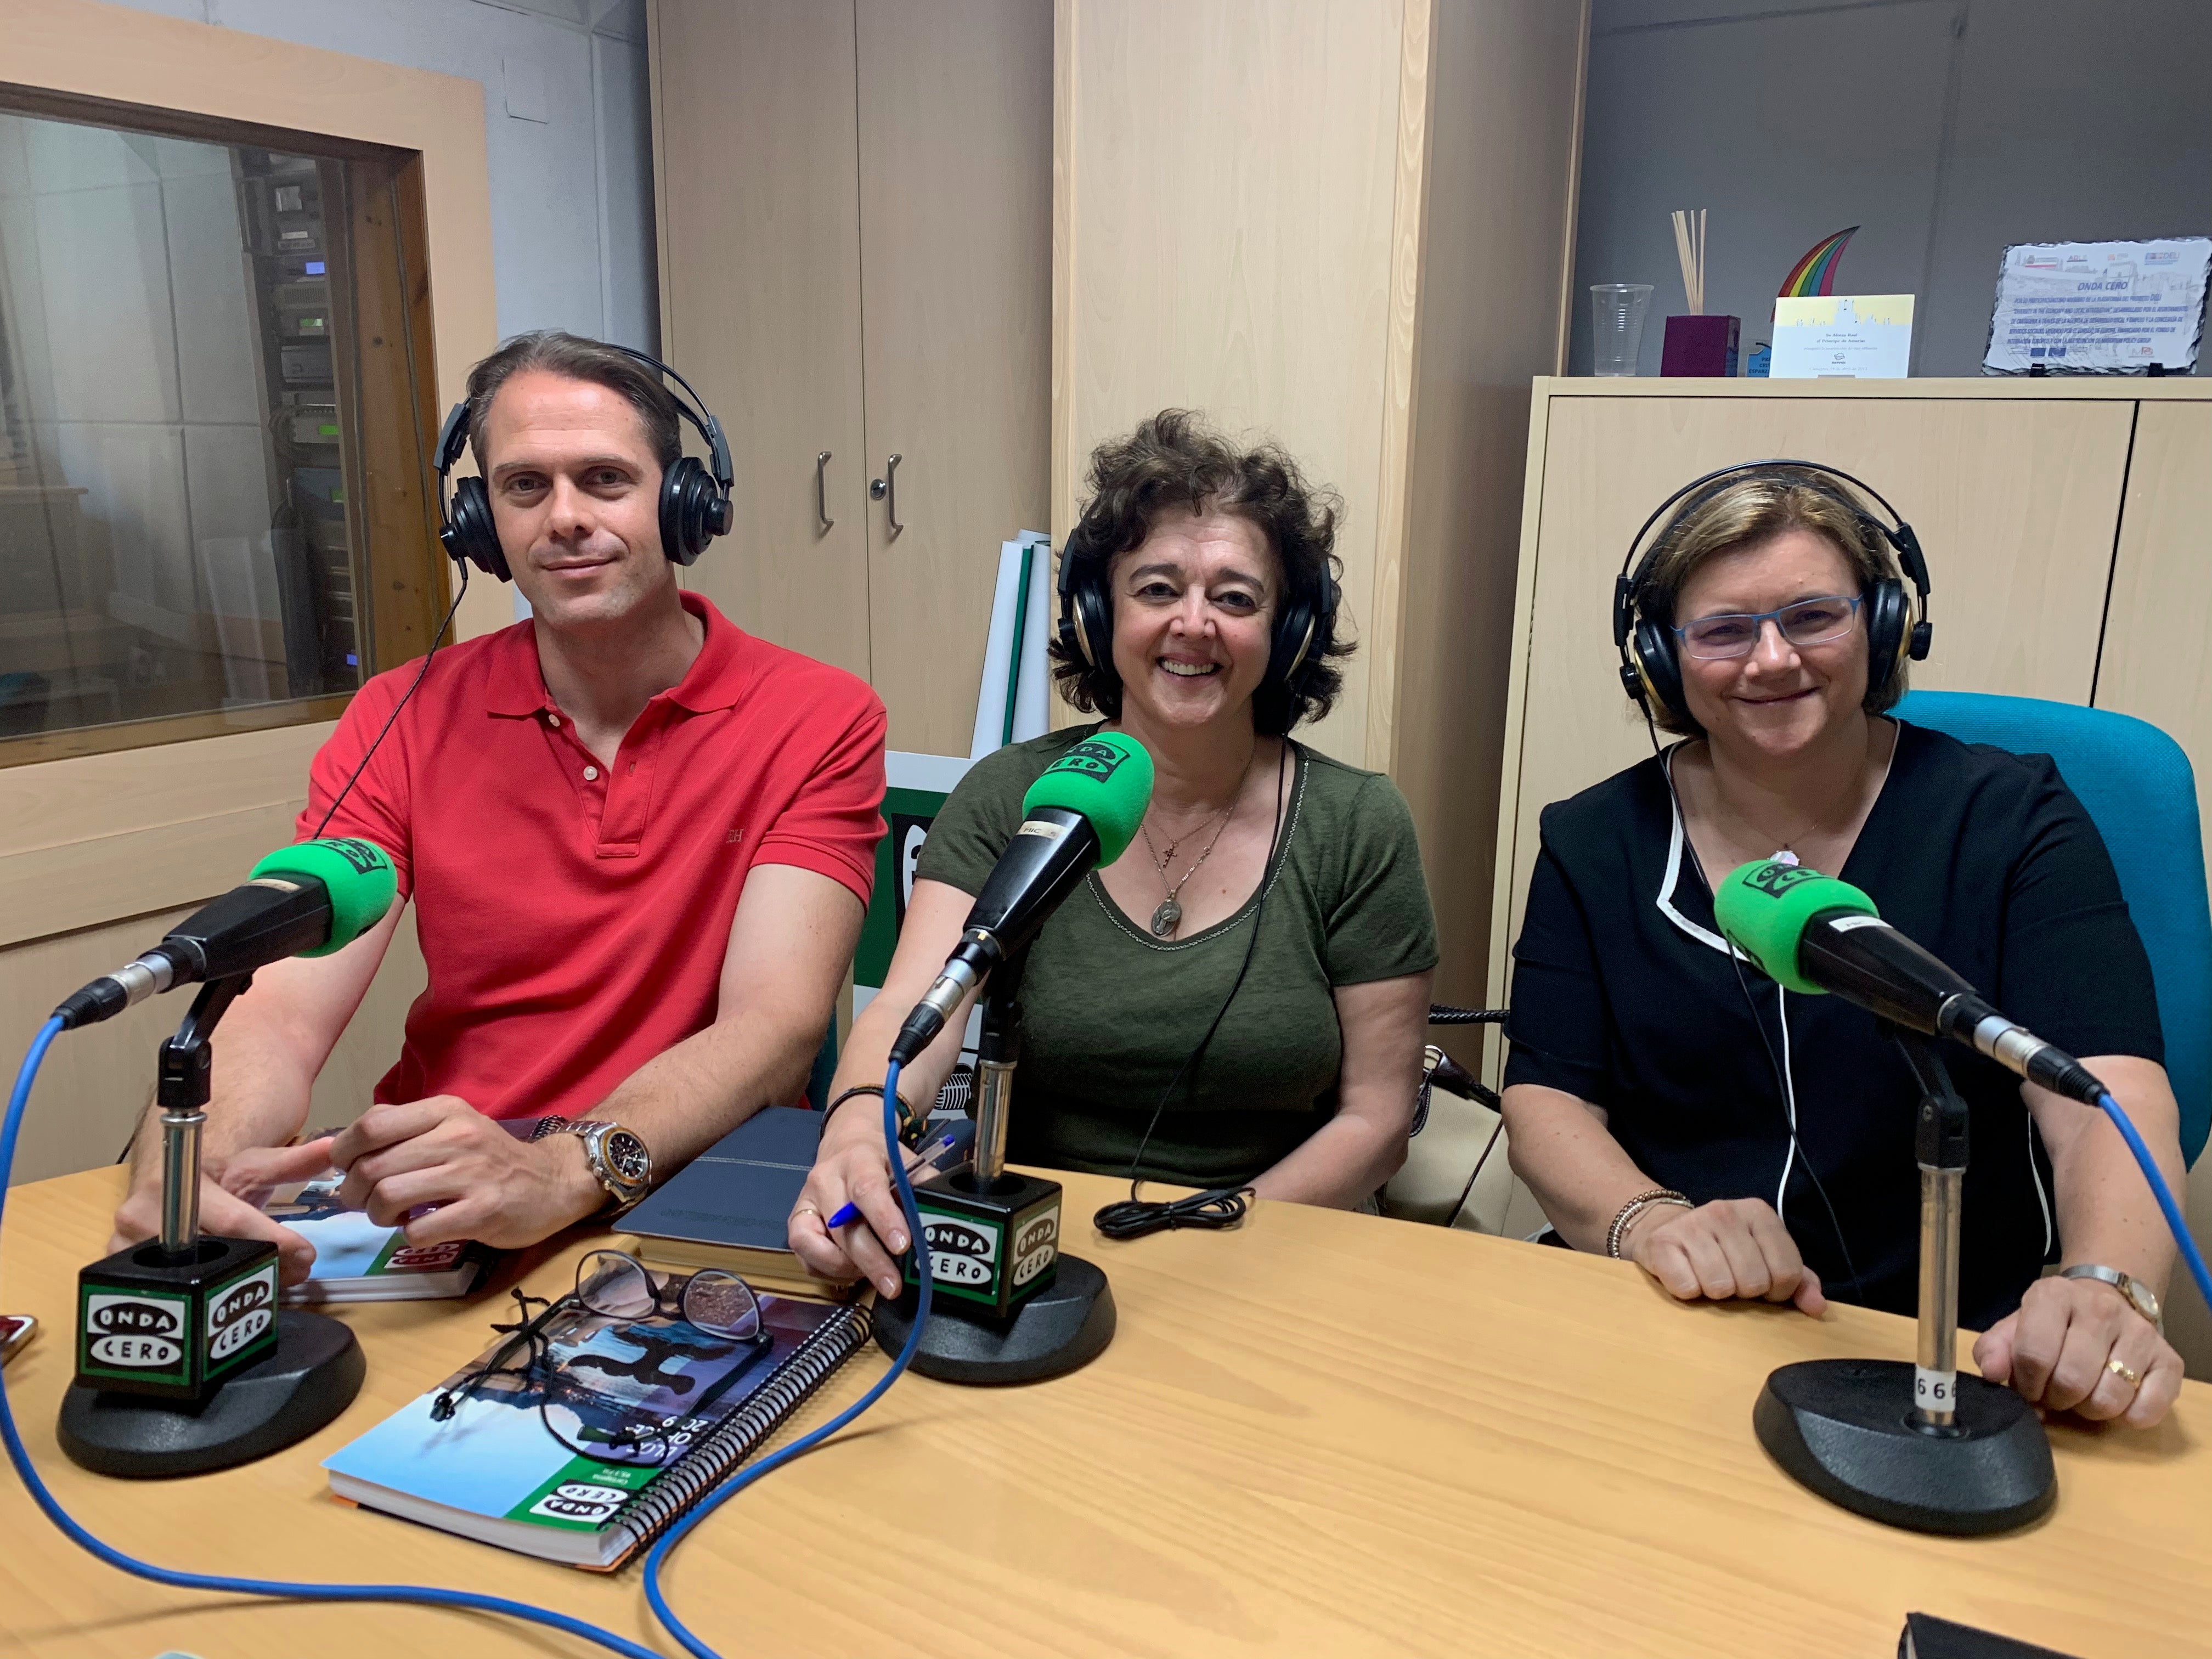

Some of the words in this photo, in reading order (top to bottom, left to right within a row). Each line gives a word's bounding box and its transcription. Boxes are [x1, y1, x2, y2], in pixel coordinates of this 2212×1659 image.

[2077, 282, 2103, 291] ONDA
[2105, 281, 2128, 290] CERO
[1051, 758, 1099, 769] ERO
[926, 1228, 985, 1253] ONDA
[1019, 1224, 1052, 1249] ONDA
[1019, 1249, 1050, 1278] CERO
[216, 1284, 266, 1323] ONDA
[100, 1310, 172, 1330] ONDA
[219, 1314, 264, 1351] CERO
[104, 1340, 169, 1360] CERO
[662, 1415, 709, 1432] 209
[565, 1488, 617, 1500] CERO
[550, 1500, 605, 1515] ONDA
